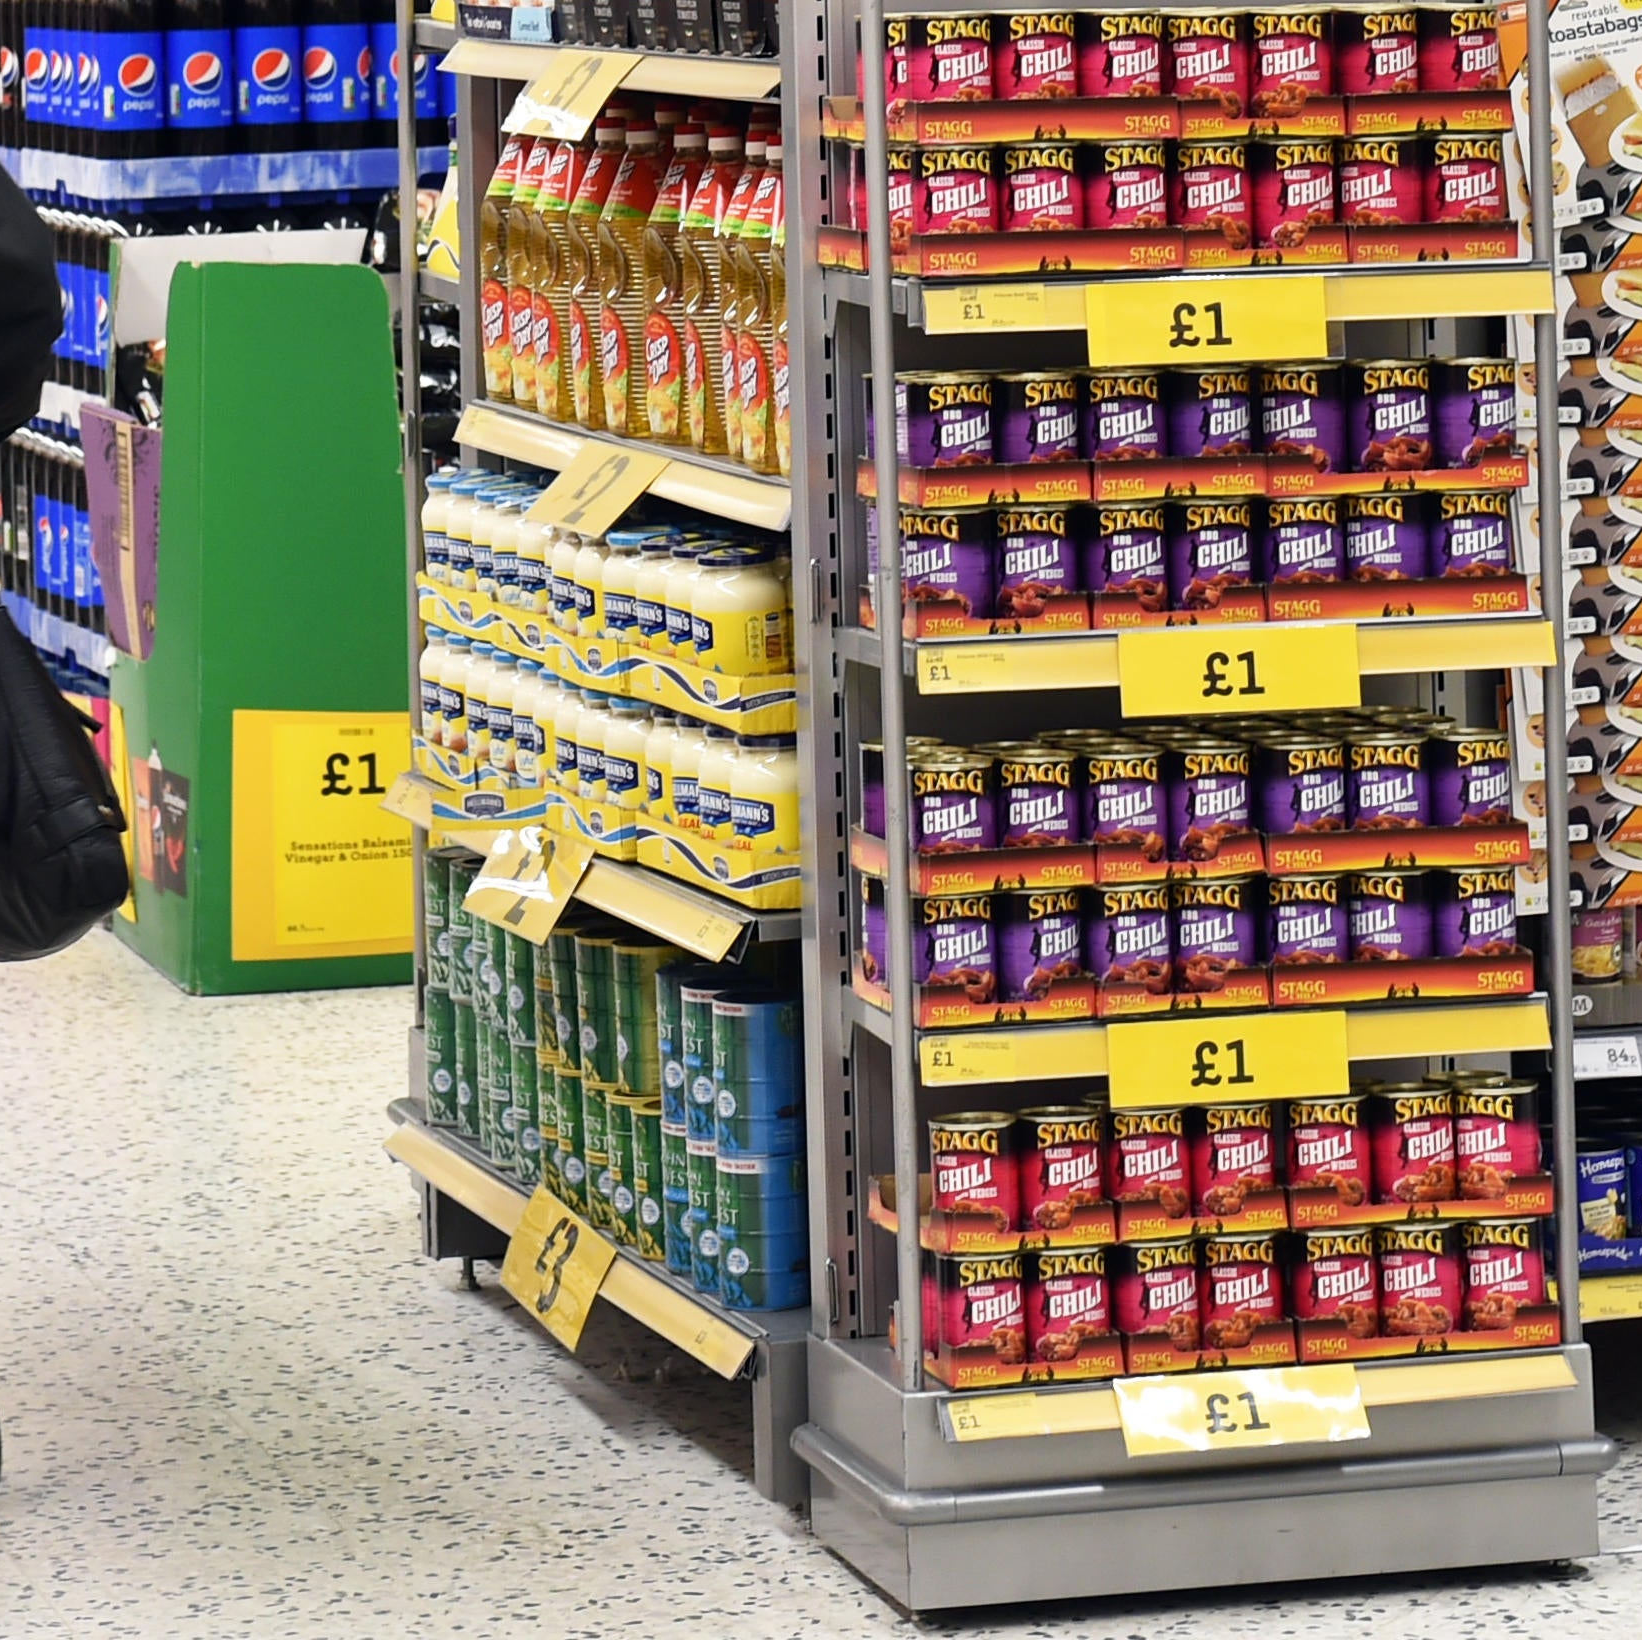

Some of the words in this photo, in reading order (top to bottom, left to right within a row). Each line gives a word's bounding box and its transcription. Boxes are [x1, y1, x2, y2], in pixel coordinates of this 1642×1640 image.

[1253, 13, 1323, 47] STAGG
[1571, 4, 1619, 21] reuseable
[1009, 14, 1075, 49] STAGG
[1168, 16, 1236, 52] STAGG
[1021, 44, 1072, 80] CHILI
[1176, 44, 1231, 79] CHILI
[1261, 42, 1318, 78] CHILI
[122, 97, 155, 113] pepsi
[925, 119, 973, 138] STAGG
[921, 144, 991, 179] STAGG
[931, 178, 987, 216] CHILI
[962, 304, 986, 321] £1
[1168, 301, 1233, 348] £1
[1363, 366, 1428, 394] STAGG
[1374, 394, 1427, 429] CHILI
[996, 512, 1065, 538] STAGG
[1005, 539, 1059, 576] CHILI
[928, 663, 952, 681] £1
[1201, 650, 1266, 698] £1
[321, 753, 386, 796] £1
[1001, 762, 1069, 789] STAGG
[1009, 790, 1065, 826] CHILI
[284, 853, 335, 865] Vinegar
[339, 853, 347, 861] &
[351, 851, 388, 861] Onion
[290, 841, 358, 851] Sensations
[1475, 839, 1521, 858] STAGG
[1173, 882, 1241, 909] STAGG
[1180, 909, 1235, 947] CHILI
[932, 1050, 955, 1069] £1
[1189, 1040, 1255, 1087] £1
[1607, 1047, 1636, 1065] 84p
[1114, 1111, 1182, 1137] STAGG
[1125, 1139, 1179, 1178] CHILI
[1462, 1223, 1529, 1249] STAGG
[533, 1215, 580, 1314] £3
[1469, 1251, 1524, 1287] CHILI
[958, 1414, 981, 1431] £1
[1205, 1391, 1270, 1434] £1
